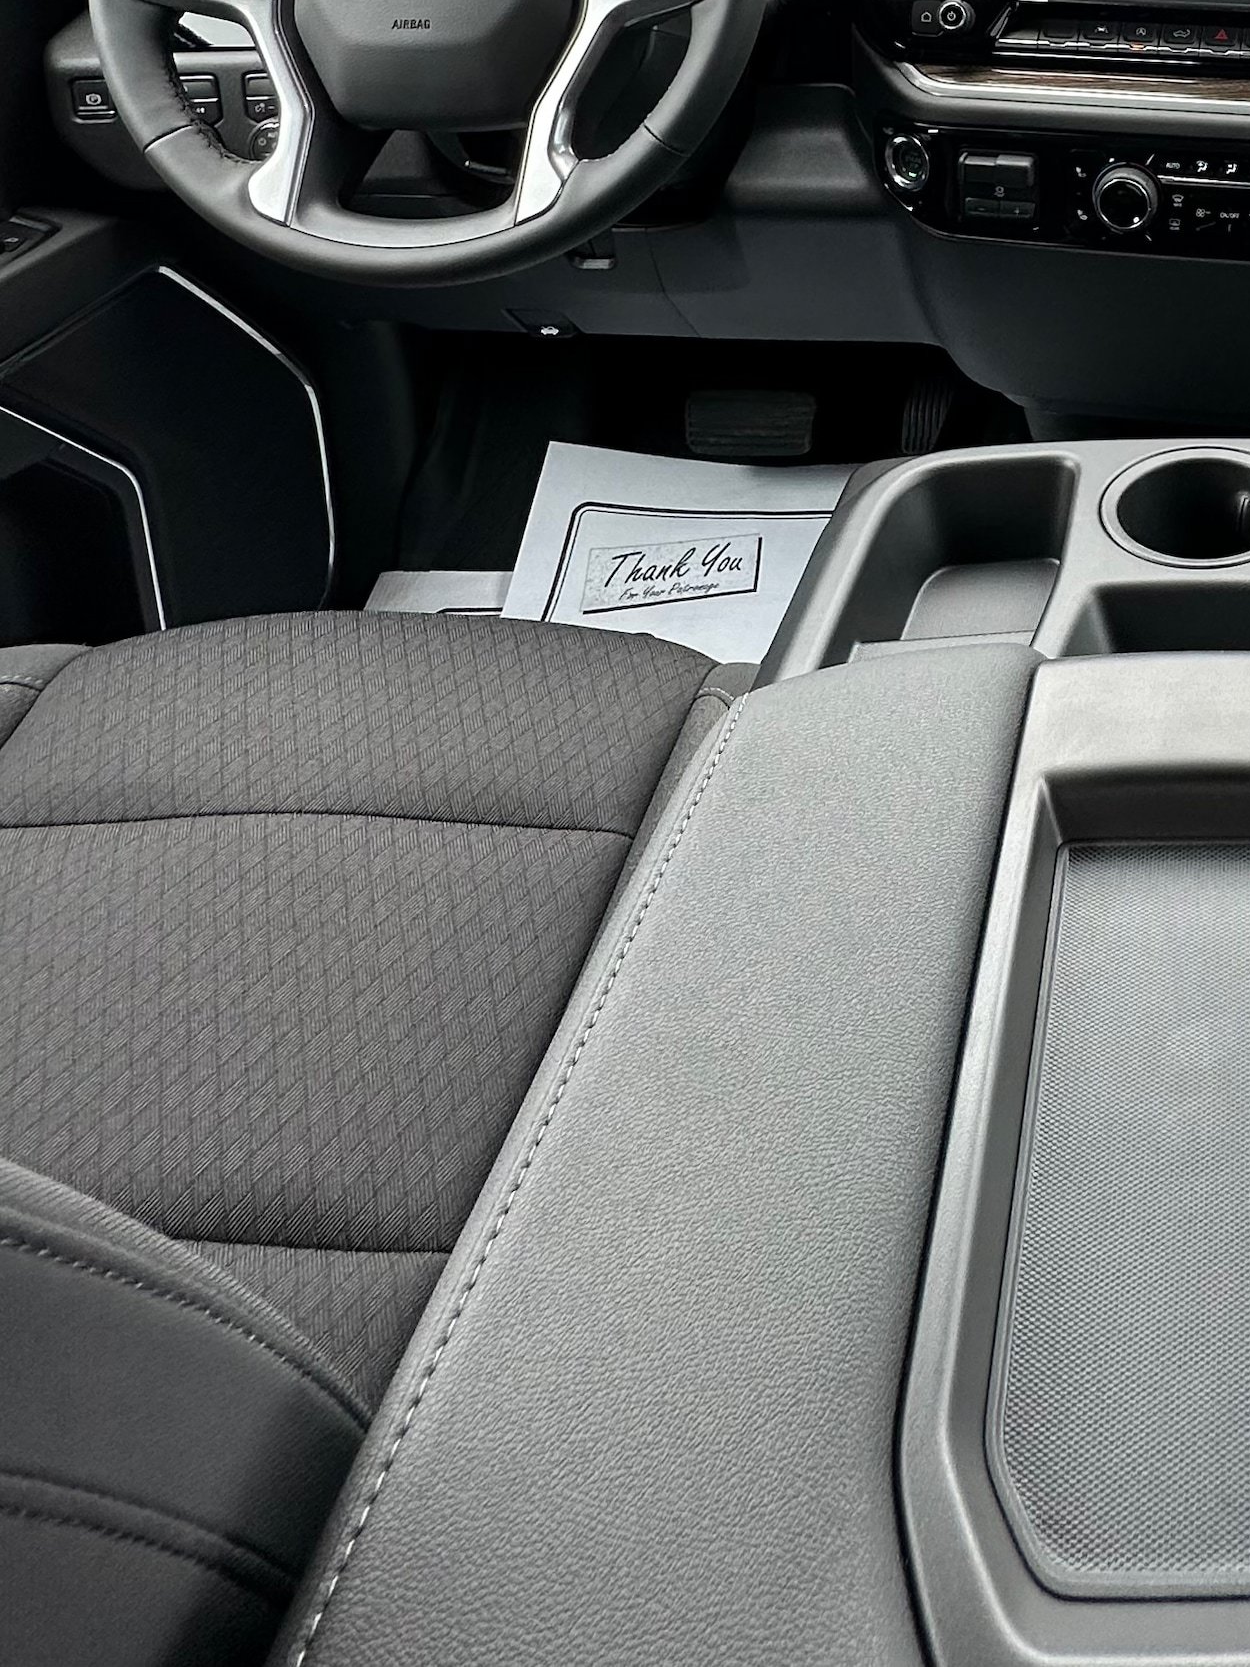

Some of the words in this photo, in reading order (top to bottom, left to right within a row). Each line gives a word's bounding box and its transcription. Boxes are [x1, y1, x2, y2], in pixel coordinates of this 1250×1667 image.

[391, 19, 431, 30] AIRBAG
[604, 546, 697, 588] Thank
[701, 541, 742, 578] You
[618, 588, 639, 601] For
[641, 585, 666, 598] Your
